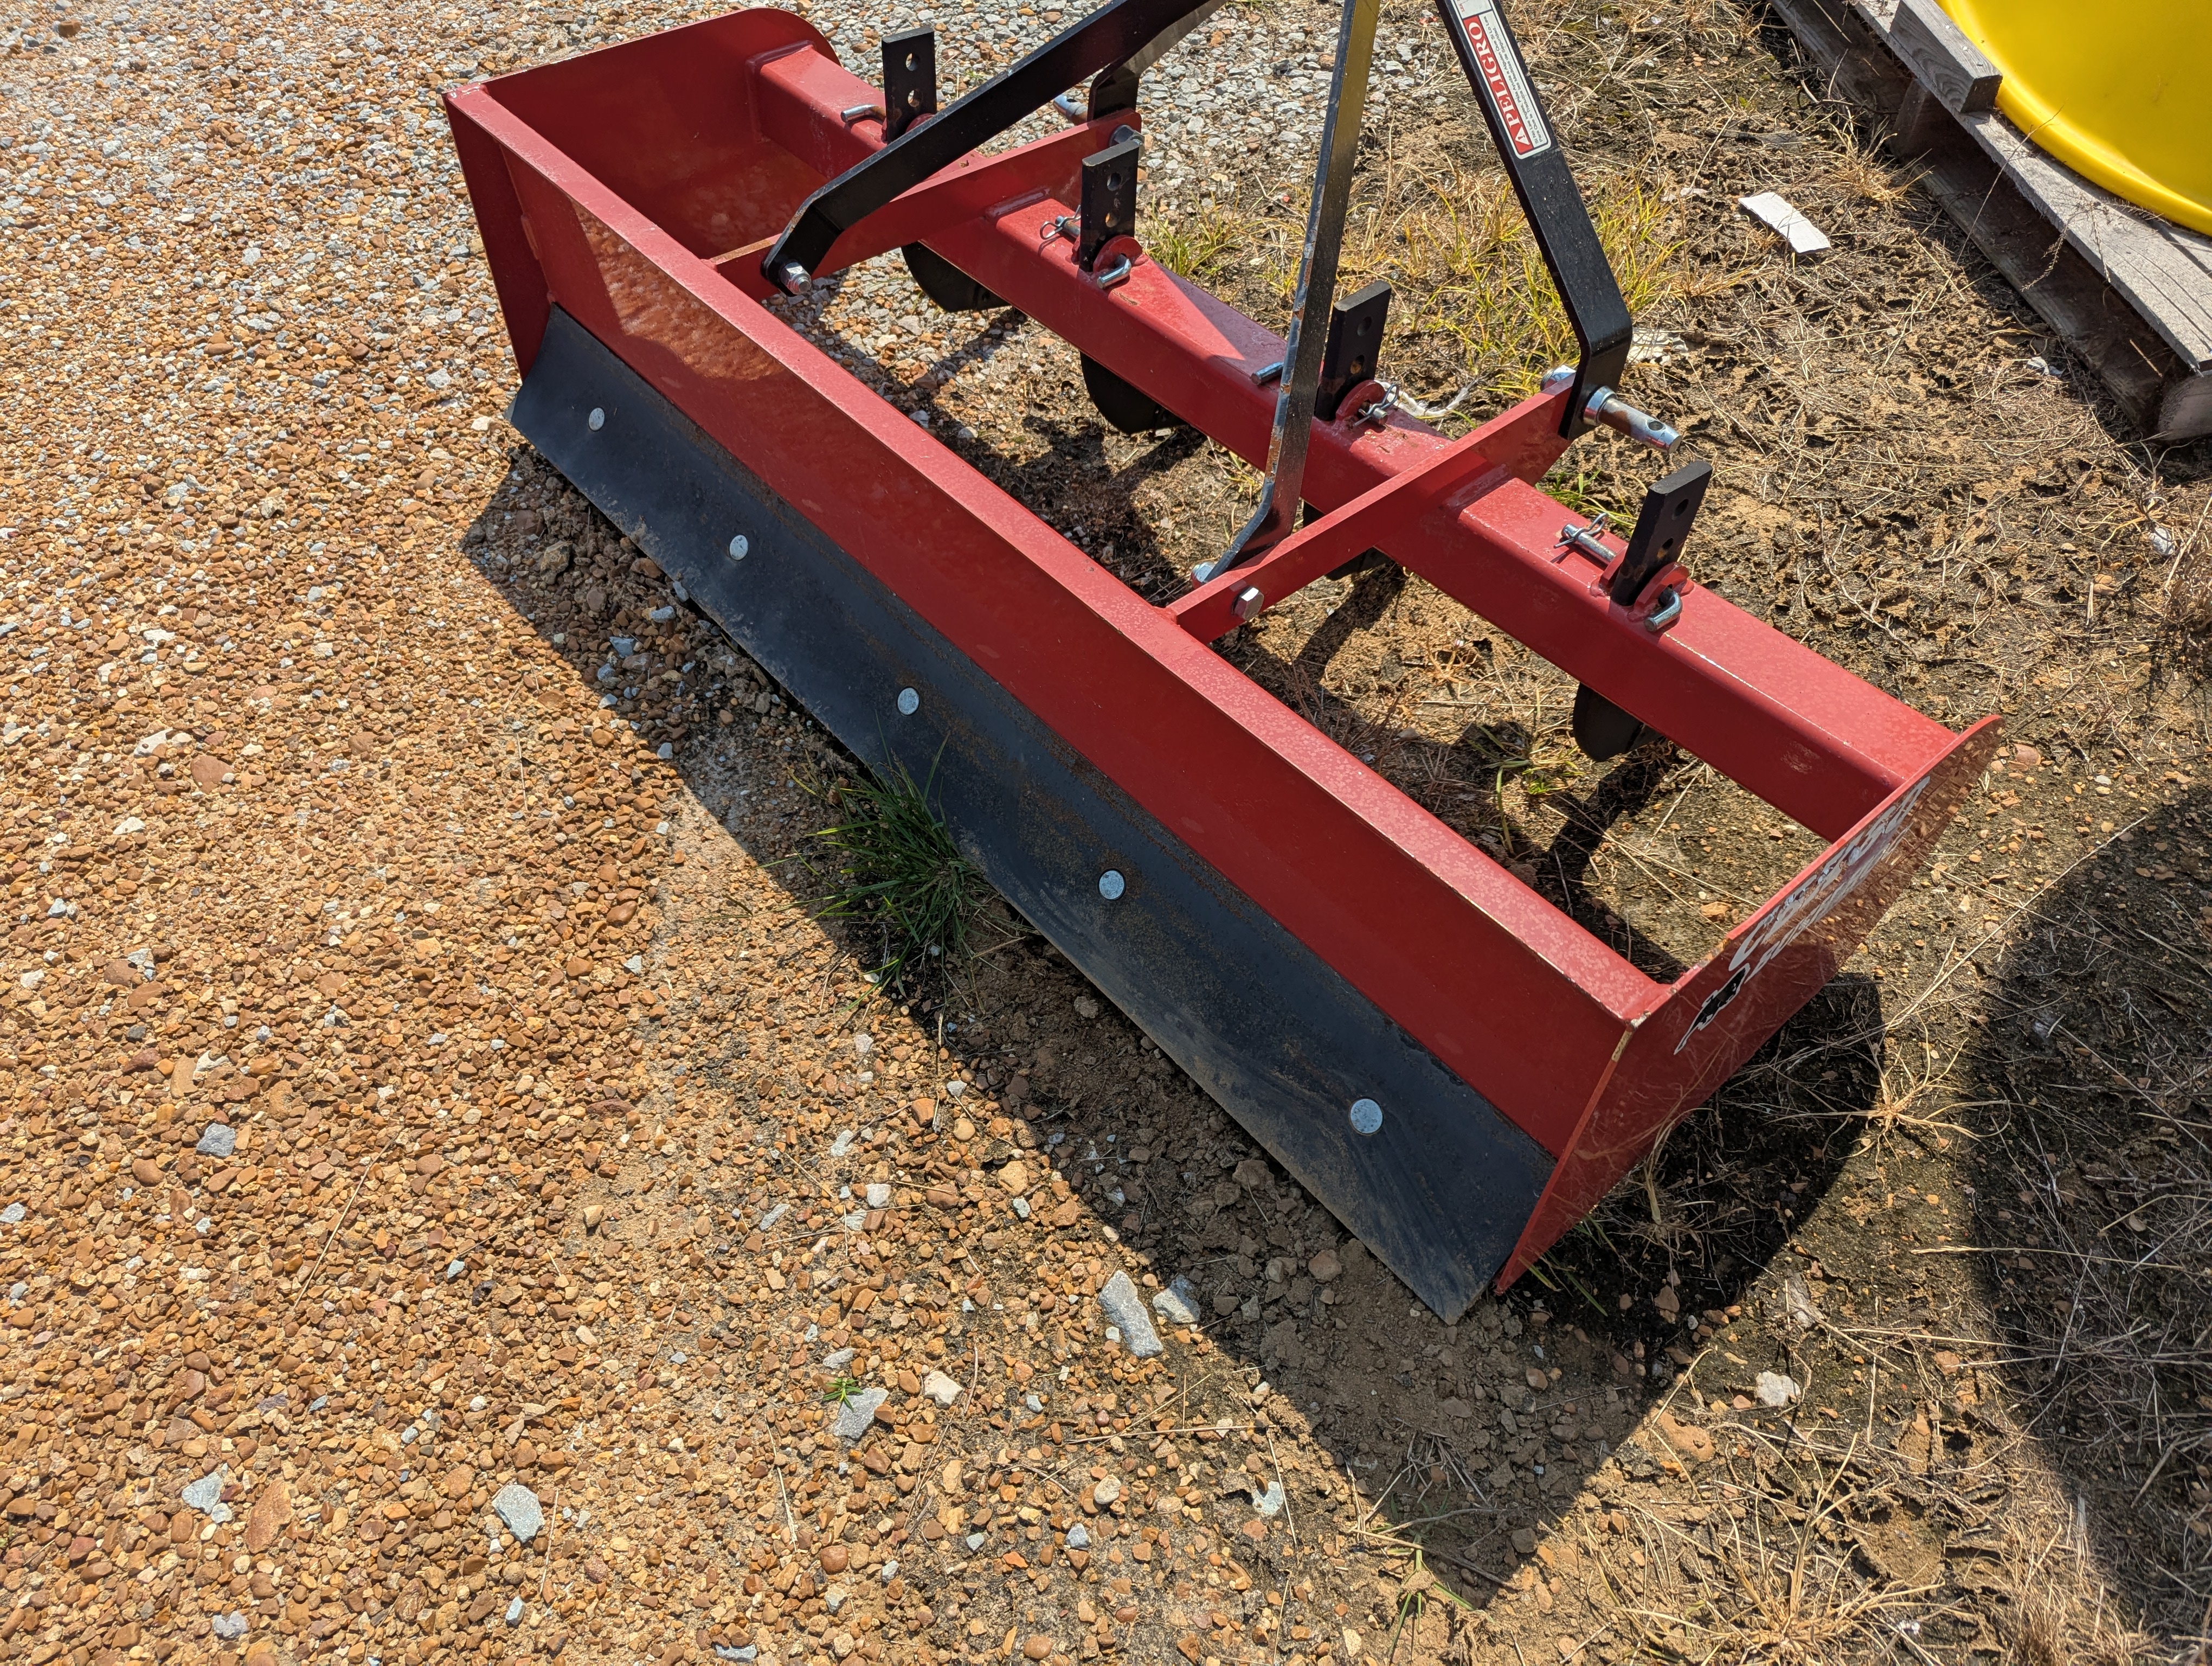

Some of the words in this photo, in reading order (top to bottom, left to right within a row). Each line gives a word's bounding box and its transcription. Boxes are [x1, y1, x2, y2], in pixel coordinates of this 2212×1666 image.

[1499, 52, 1508, 70] Alguien
[1507, 61, 1517, 81] Medidas
[1469, 22, 1521, 128] PELIGRO
[1508, 75, 1516, 90] Ayuda
[1519, 90, 1531, 112] Traduzca
